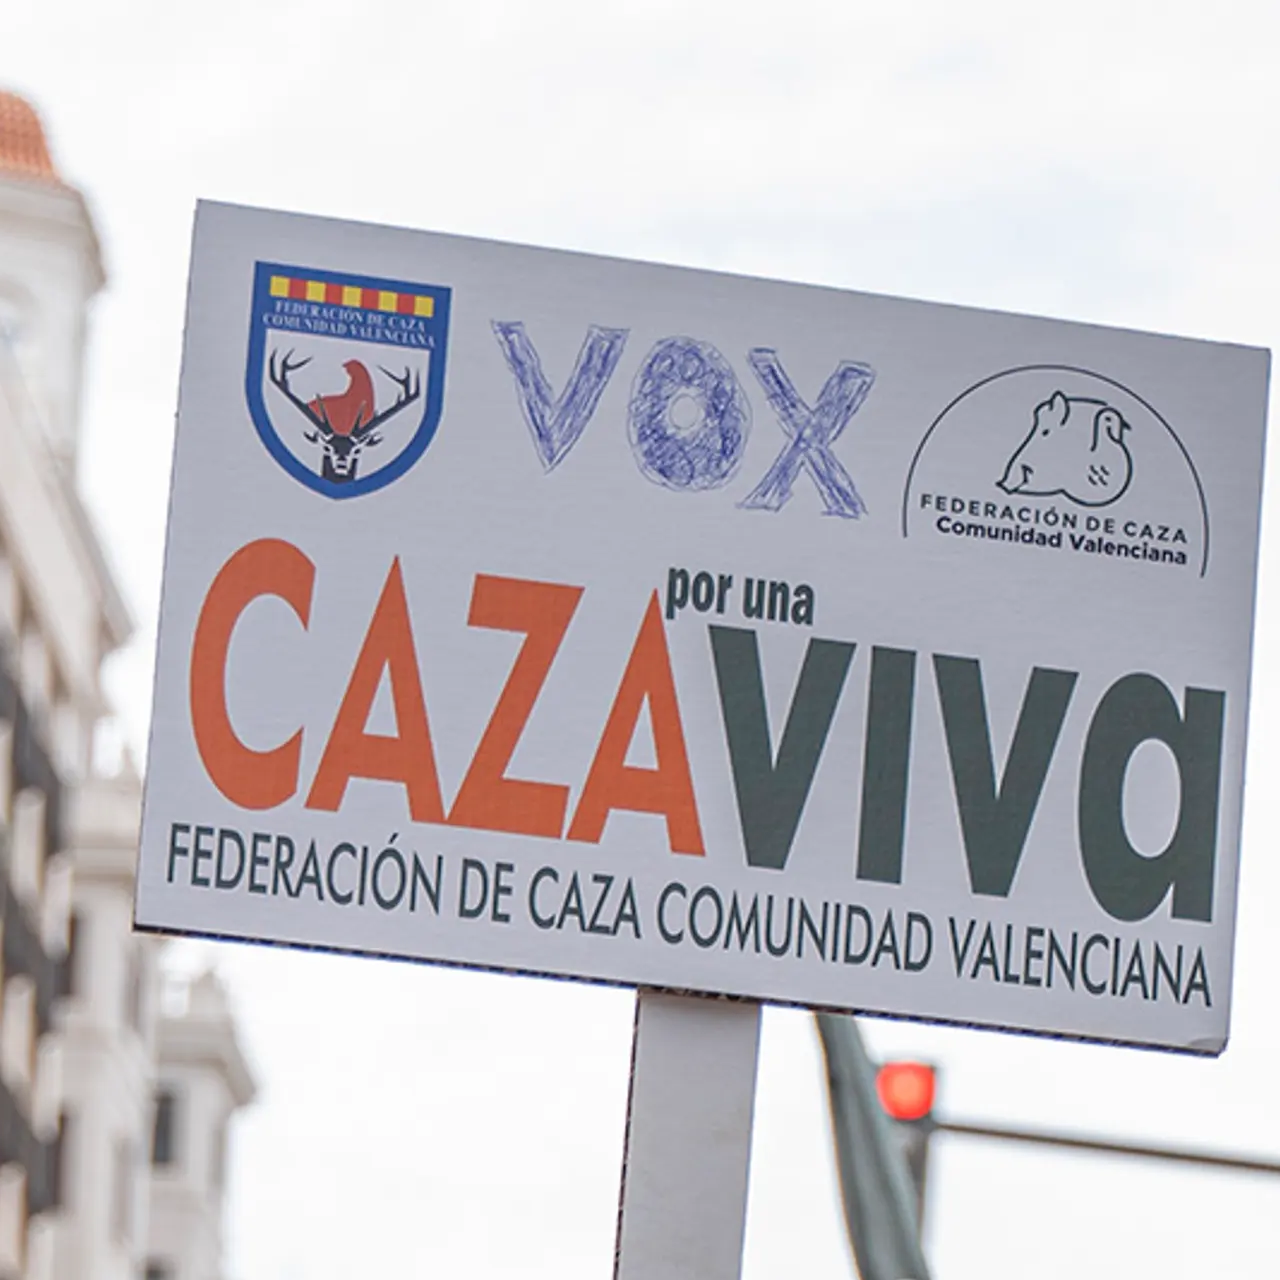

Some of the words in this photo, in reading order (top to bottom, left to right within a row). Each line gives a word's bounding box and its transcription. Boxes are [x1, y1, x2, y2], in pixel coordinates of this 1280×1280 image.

[263, 313, 347, 334] COMUNIDAD
[349, 326, 436, 347] VALENCIANA
[275, 301, 363, 323] FEDERACIÓN
[367, 312, 383, 325] DE
[387, 315, 426, 333] CAZA
[490, 319, 878, 520] VOX
[920, 494, 1077, 529] FEDERACIÓN
[1086, 516, 1115, 534] DE
[1123, 521, 1188, 544] CAZA
[936, 516, 1062, 548] Comunidad
[1069, 533, 1188, 565] Valenciana
[666, 567, 733, 620] por
[742, 577, 815, 626] una
[189, 536, 706, 857] CAZA
[167, 823, 443, 915] FEDERACIÓN
[458, 858, 514, 923] DE
[528, 866, 641, 940] CAZA
[657, 882, 933, 972] COMUNIDAD
[948, 916, 1212, 1008] VALENCIANA
